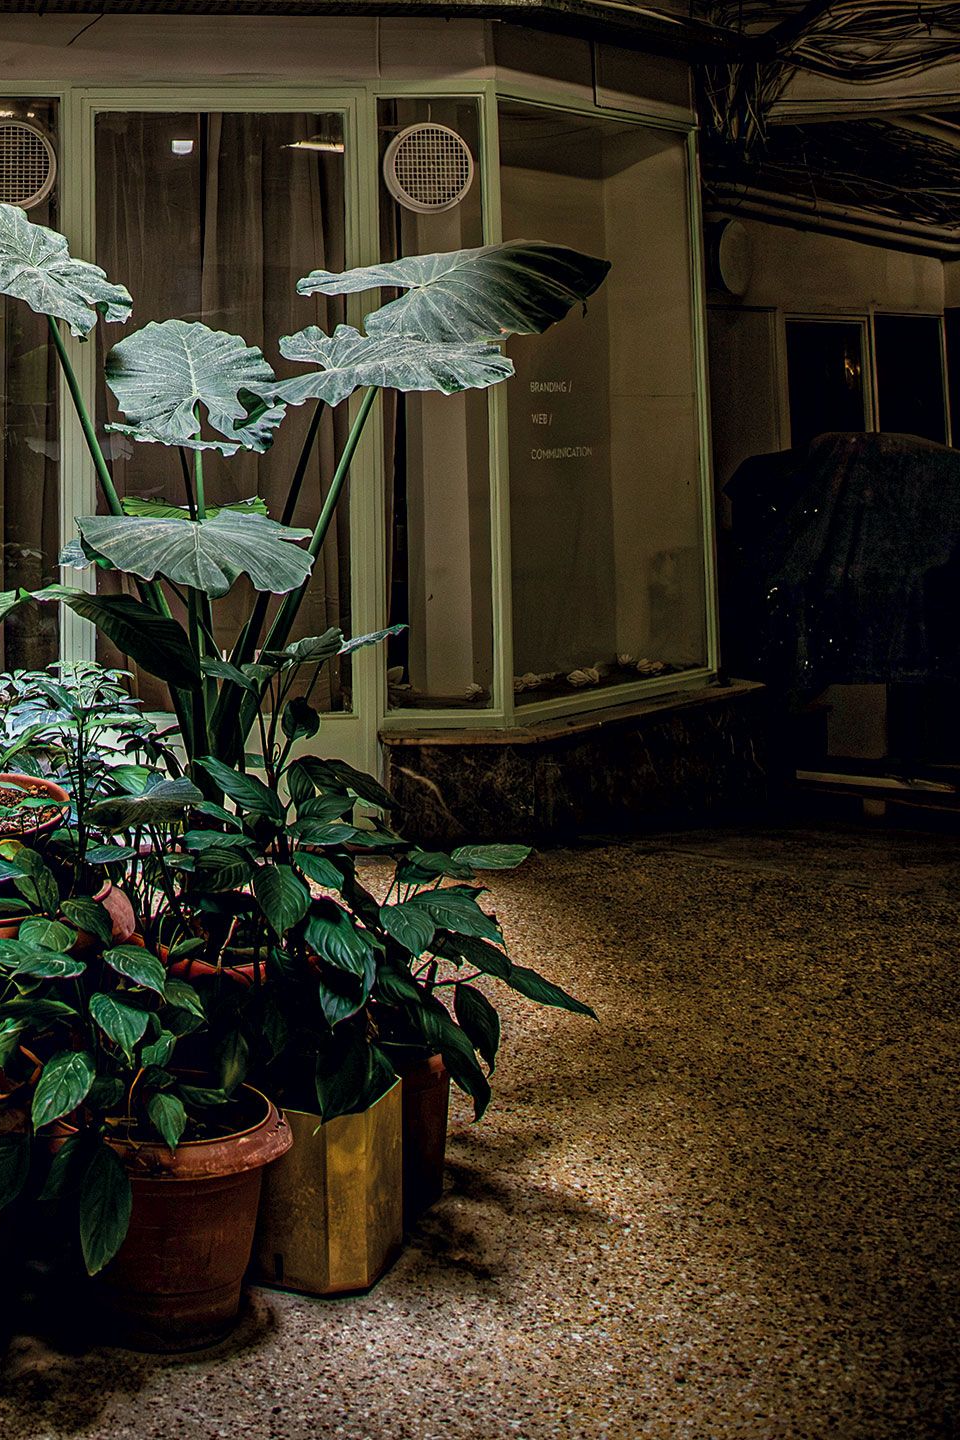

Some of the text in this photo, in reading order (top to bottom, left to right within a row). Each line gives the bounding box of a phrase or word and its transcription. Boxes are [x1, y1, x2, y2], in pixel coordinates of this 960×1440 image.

[530, 381, 567, 393] BRANDING
[531, 413, 548, 425] WEB
[531, 446, 593, 460] COMMUNICATION
